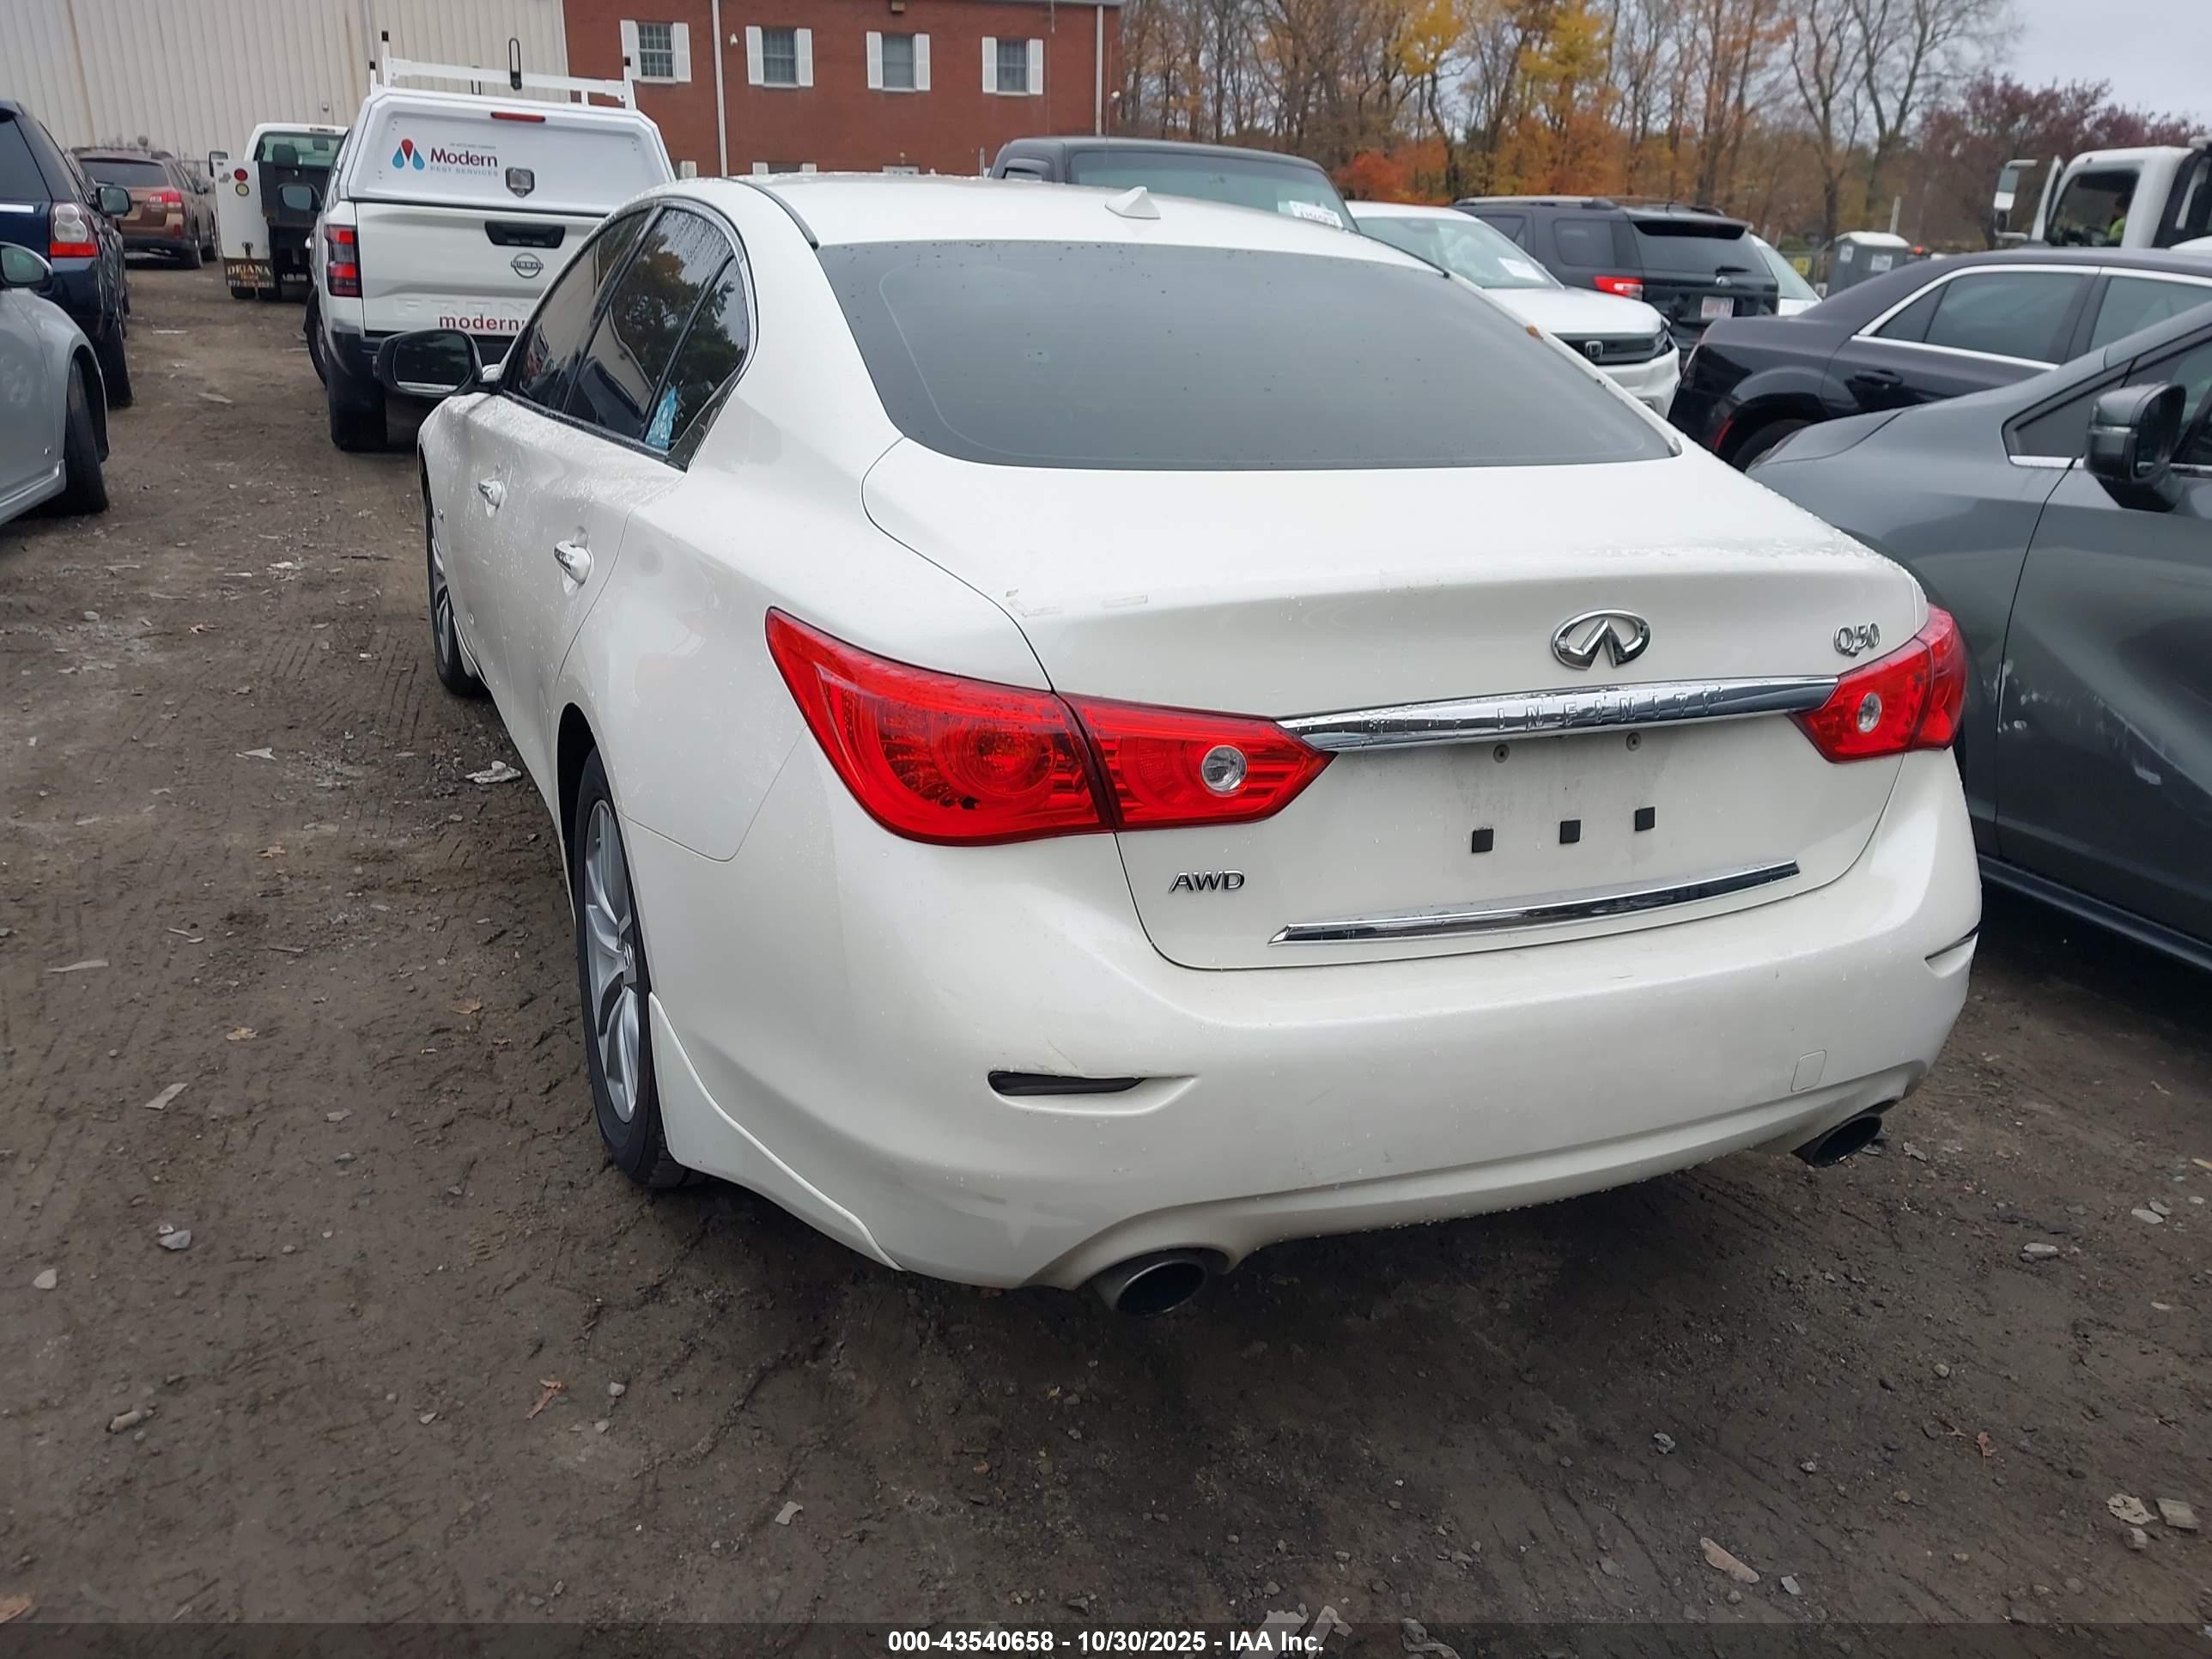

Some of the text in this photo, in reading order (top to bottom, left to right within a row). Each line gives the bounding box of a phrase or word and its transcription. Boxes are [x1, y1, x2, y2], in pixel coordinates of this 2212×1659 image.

[430, 147, 498, 168] Modern
[1833, 622, 1881, 658] Q50
[1497, 690, 1711, 732] INFINITI
[1168, 870, 1245, 894] AWD
